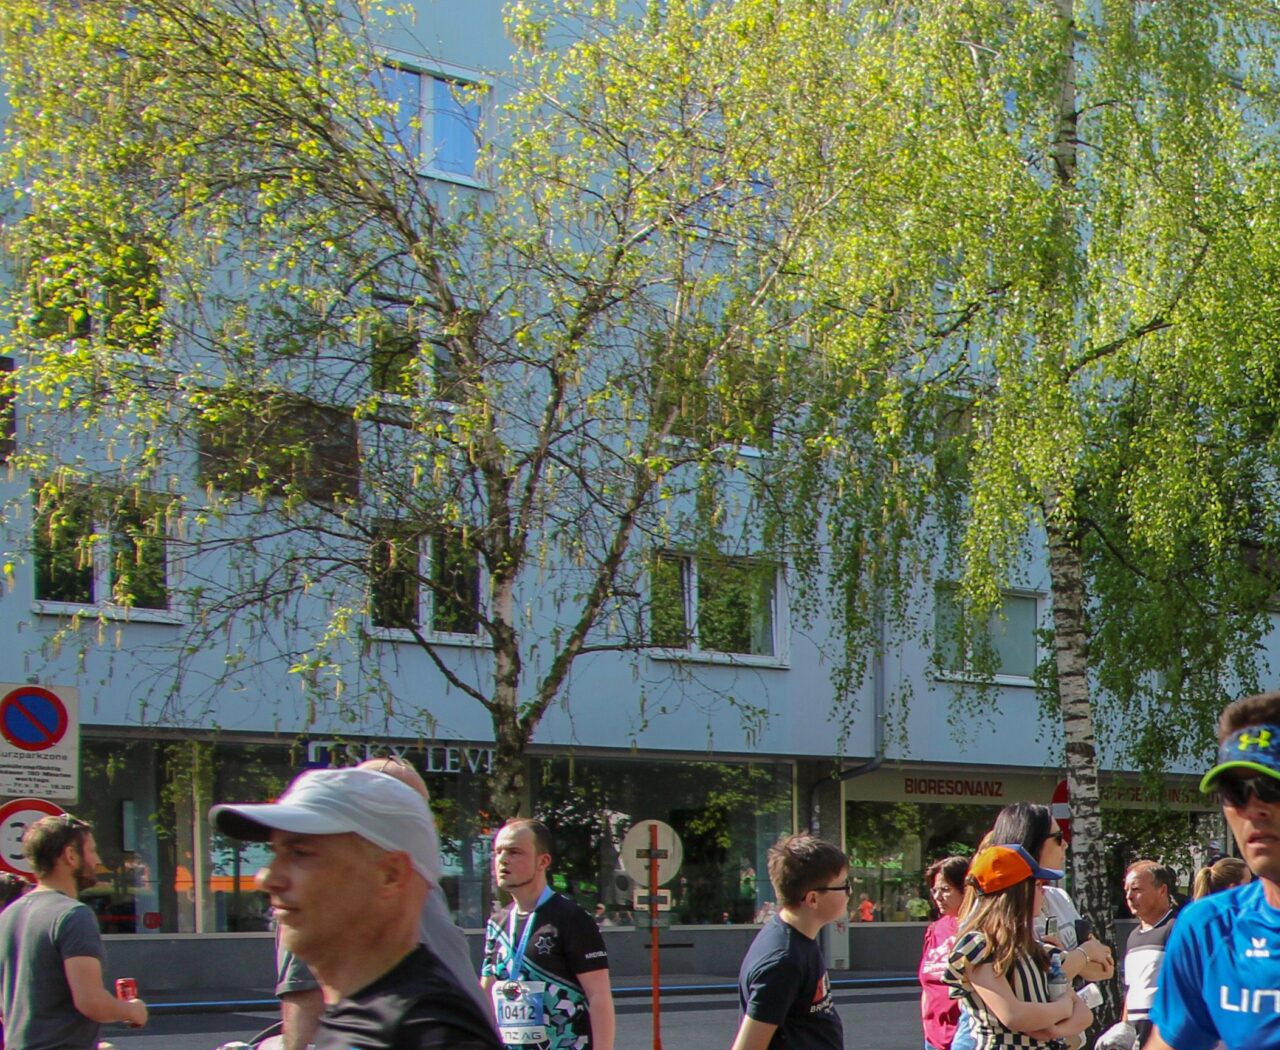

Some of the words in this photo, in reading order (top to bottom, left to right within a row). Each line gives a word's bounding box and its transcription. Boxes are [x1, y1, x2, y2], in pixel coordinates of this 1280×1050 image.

[1, 751, 68, 761] urzparkzone
[904, 778, 1003, 797] BIORESONANZ
[9, 822, 25, 860] 3
[499, 1005, 536, 1020] 10412
